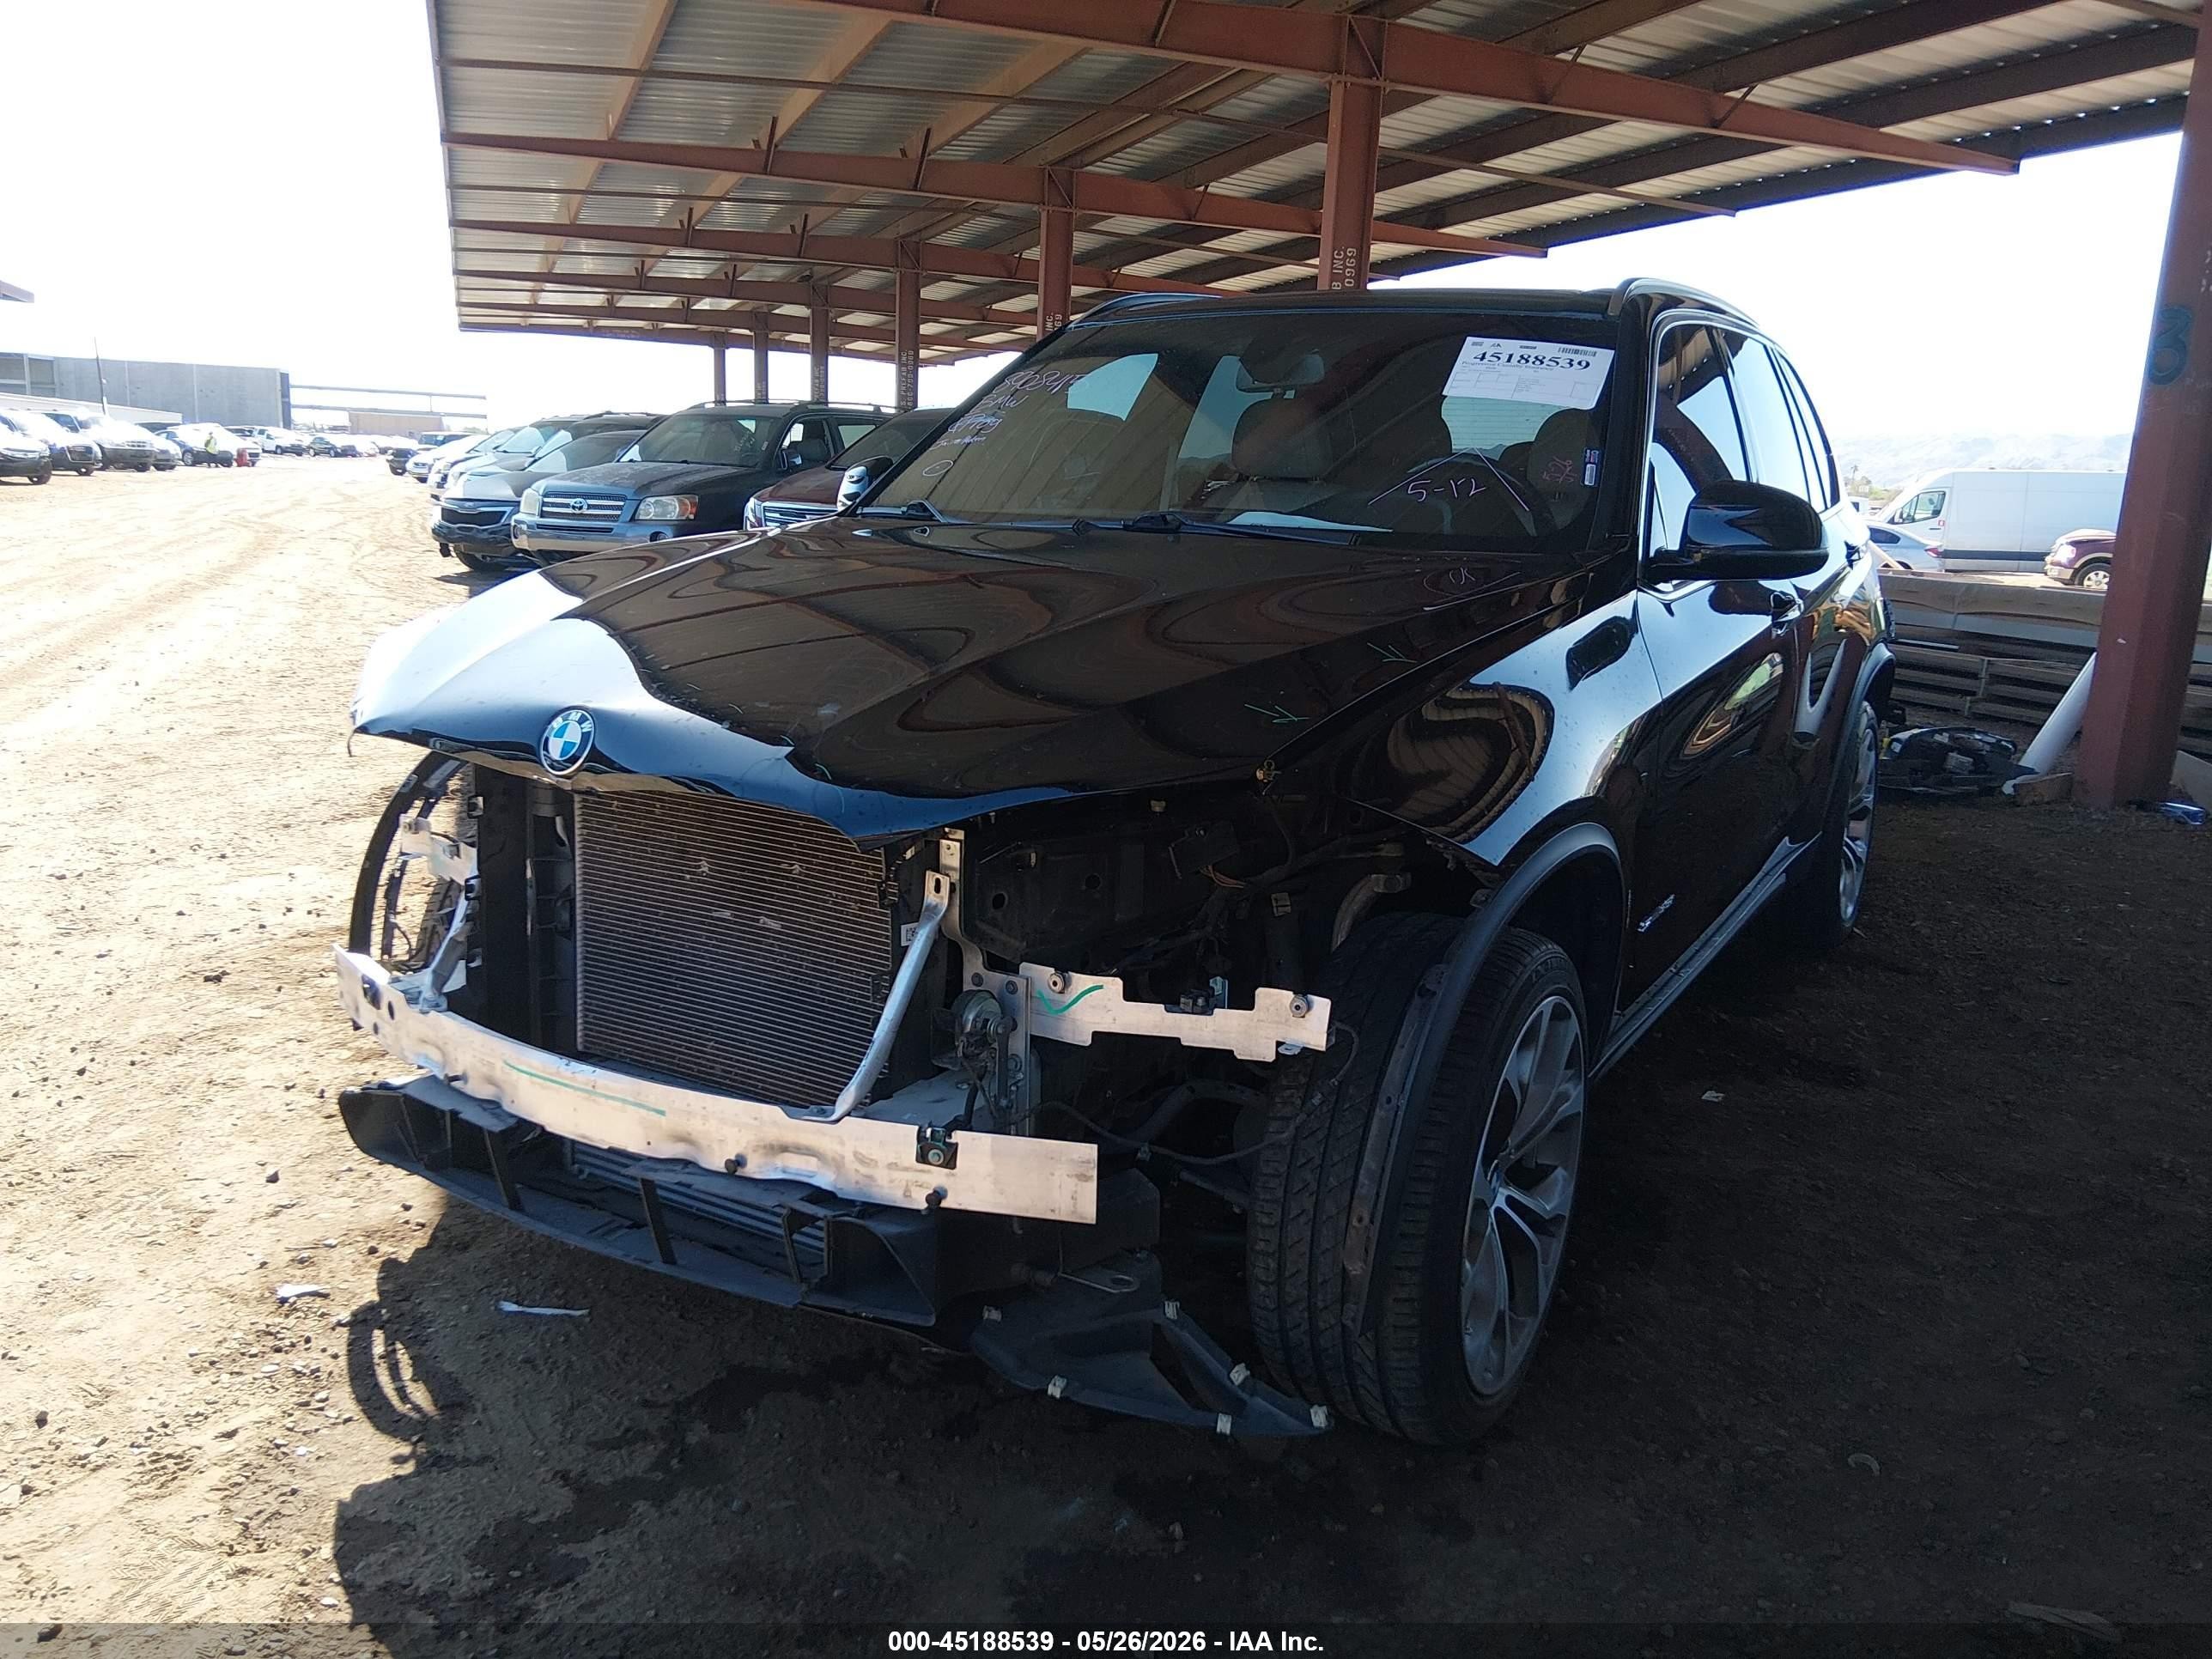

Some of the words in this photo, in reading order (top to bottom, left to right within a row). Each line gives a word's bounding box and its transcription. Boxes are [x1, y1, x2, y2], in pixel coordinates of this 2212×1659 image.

[1333, 246, 1344, 274] INC.
[1046, 313, 1054, 331] INC.
[1473, 350, 1591, 371] 45188539
[1407, 477, 1487, 502] 5-12
